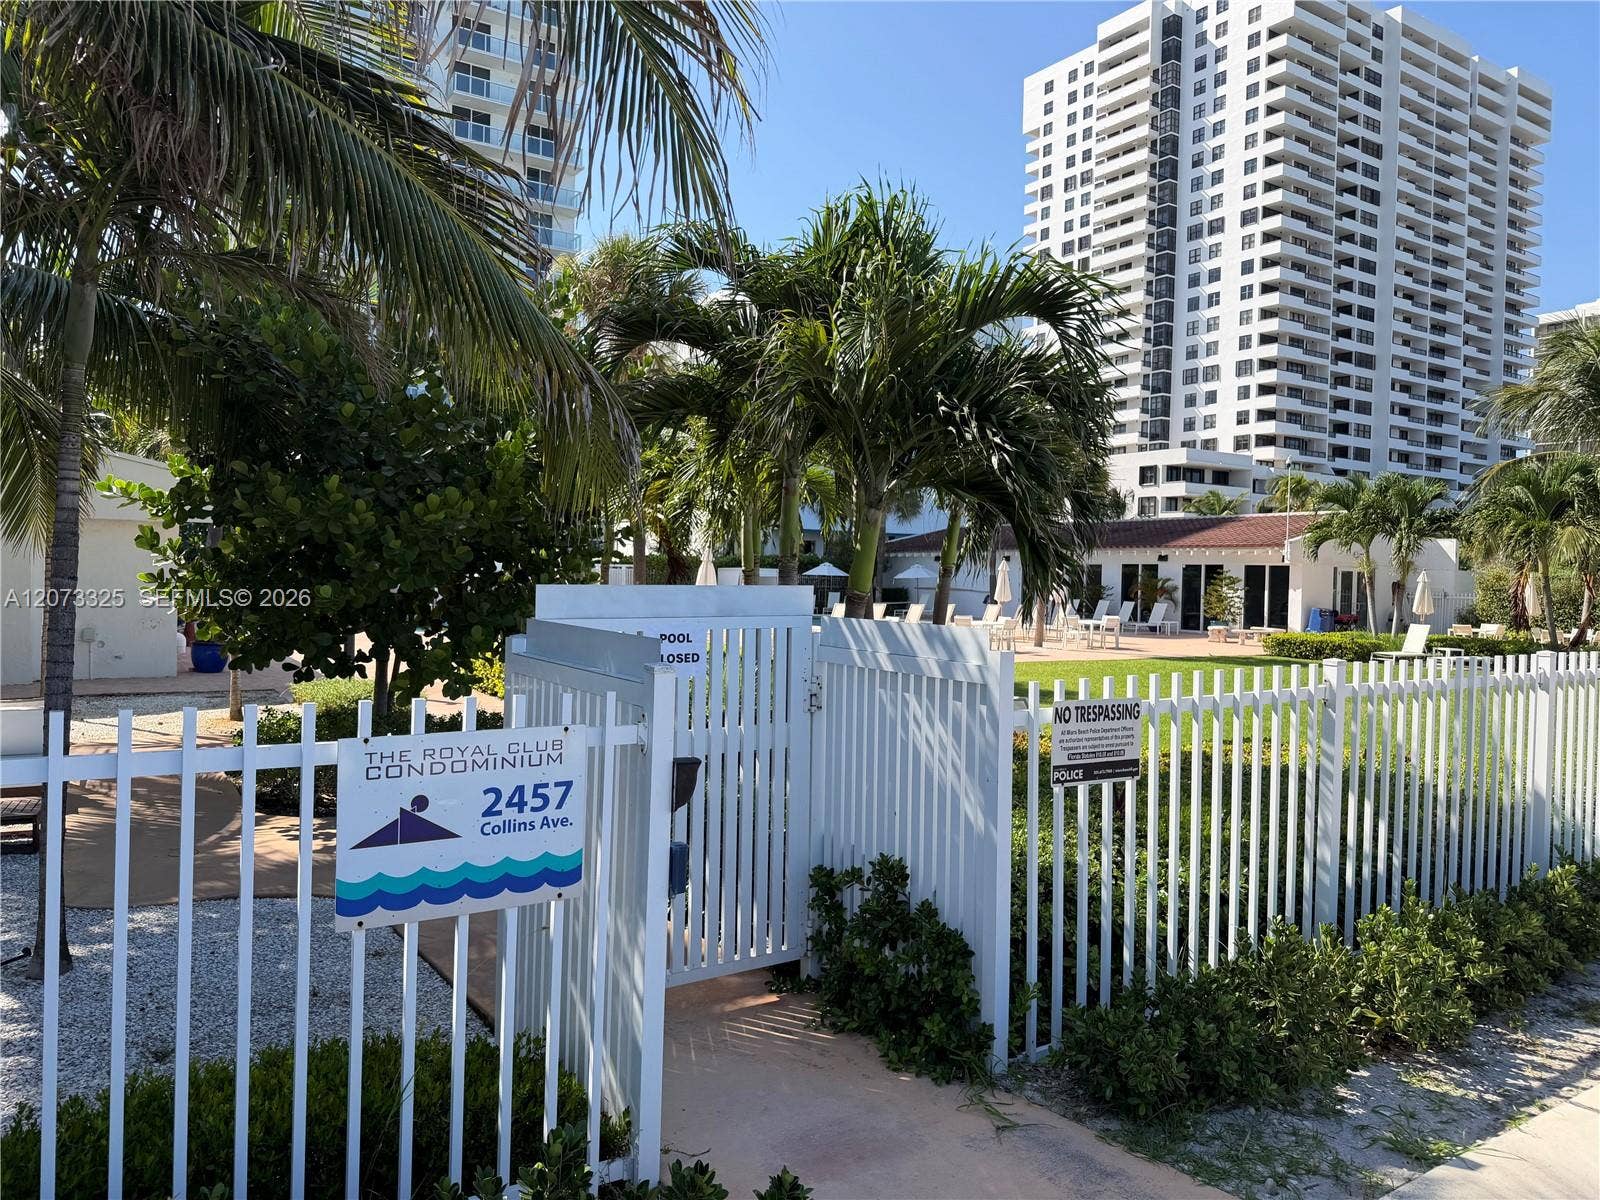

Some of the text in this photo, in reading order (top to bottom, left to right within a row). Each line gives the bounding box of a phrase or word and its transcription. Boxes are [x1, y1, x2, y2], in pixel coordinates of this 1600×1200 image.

[660, 633, 693, 644] POOL
[660, 653, 700, 664] LOSED
[1054, 702, 1140, 724] NO TRESPASSING
[1101, 726, 1120, 734] Department
[364, 739, 563, 764] THE ROYAL CLUB
[366, 751, 563, 780] CONDOMINIUM
[1053, 769, 1084, 782] POLICE
[481, 780, 574, 818] 2457
[480, 815, 573, 836] Collins Ave.
